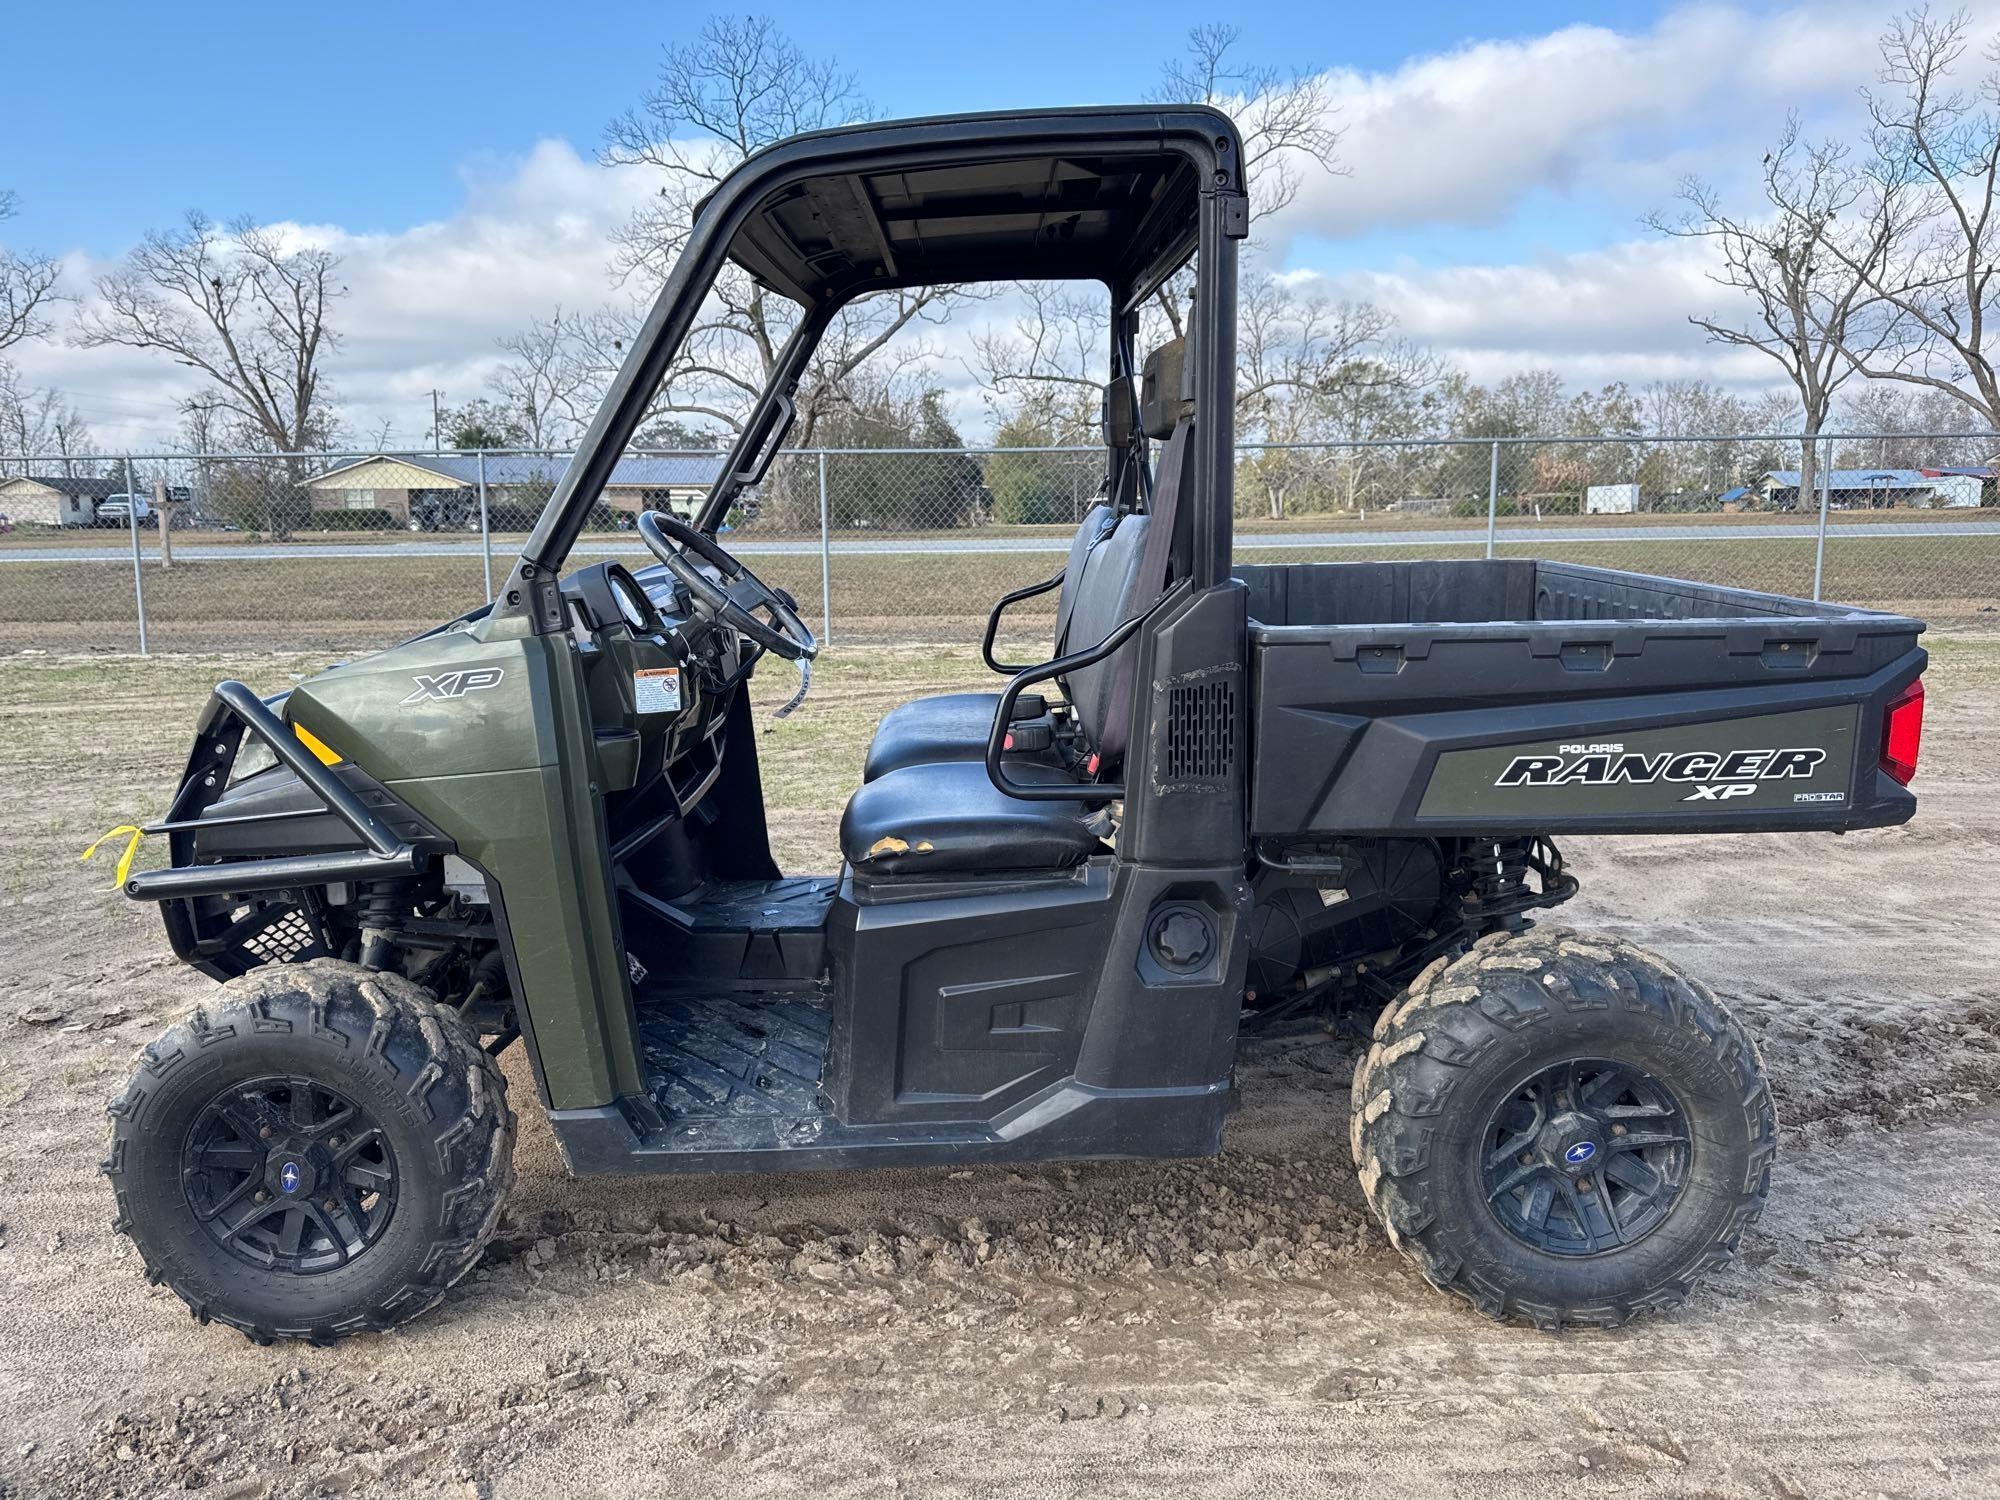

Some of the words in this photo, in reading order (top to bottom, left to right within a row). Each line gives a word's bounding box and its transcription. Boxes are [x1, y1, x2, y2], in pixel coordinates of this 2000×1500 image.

[399, 667, 504, 704] XP
[1559, 743, 1624, 754] POLARIS
[1494, 748, 1826, 786] RANGER
[1679, 783, 1758, 801] XP
[1794, 792, 1845, 802] PROSTAR
